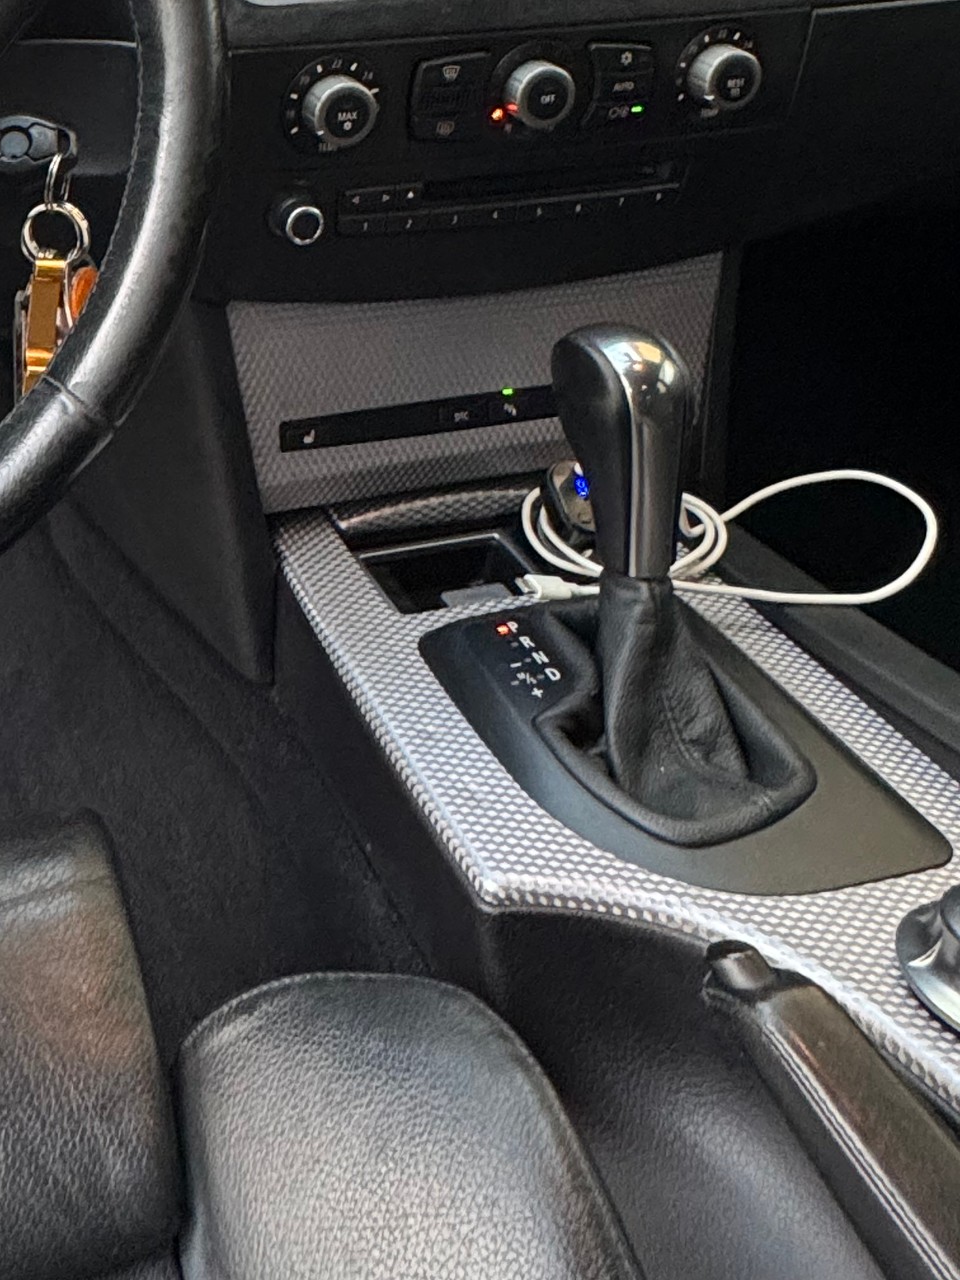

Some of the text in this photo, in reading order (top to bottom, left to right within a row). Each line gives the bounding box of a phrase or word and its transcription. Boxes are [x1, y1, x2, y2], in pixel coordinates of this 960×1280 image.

[540, 93, 557, 105] OFF
[337, 111, 359, 122] MAX
[505, 621, 519, 634] P
[518, 636, 536, 649] R
[531, 650, 550, 665] N
[544, 667, 562, 682] D
